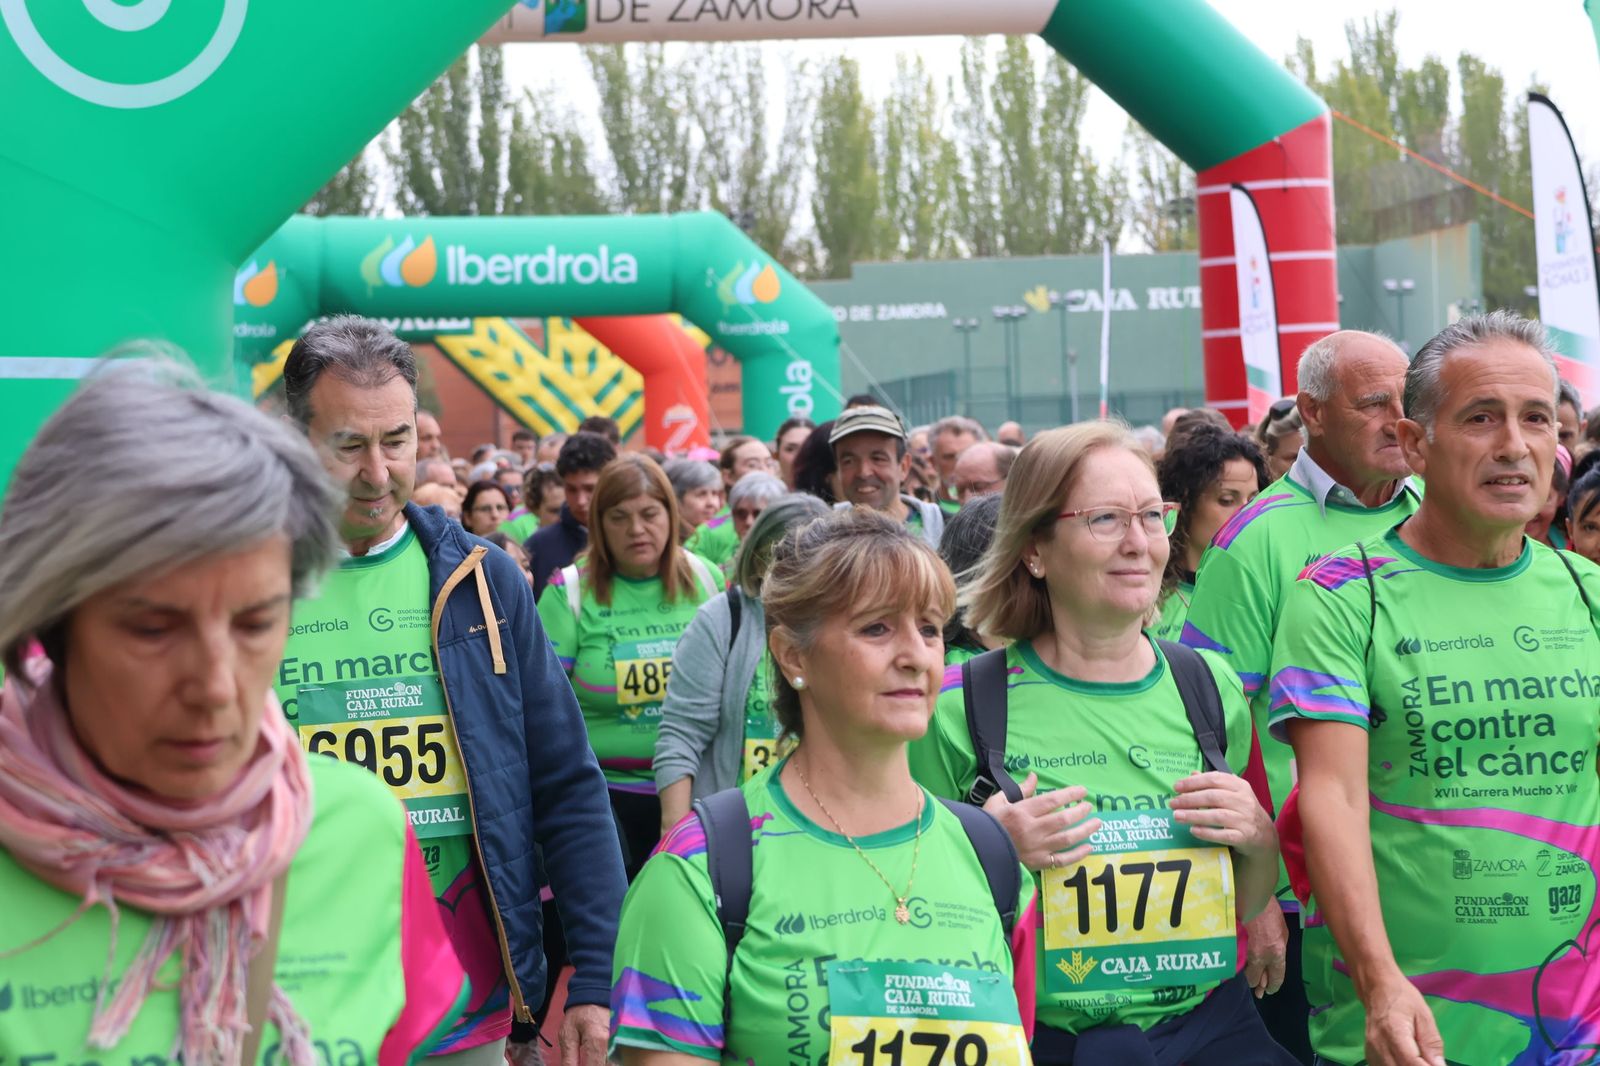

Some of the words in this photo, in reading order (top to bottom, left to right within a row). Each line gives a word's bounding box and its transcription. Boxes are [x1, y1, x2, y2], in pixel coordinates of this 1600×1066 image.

[595, 0, 650, 23] DE
[666, 0, 861, 22] ZAMORA
[446, 243, 638, 285] Iberdrola
[1066, 287, 1138, 312] CAA
[876, 302, 948, 322] ZAMORA
[409, 621, 432, 629] Zamor
[1423, 634, 1495, 653] Iberdrola
[279, 657, 324, 686] En
[1426, 674, 1475, 706] En
[346, 700, 378, 712] CAJA
[381, 695, 424, 709] RURAL
[347, 711, 358, 719] DE
[360, 709, 391, 719] ZAMORA
[1401, 676, 1429, 778] ZAMORA
[1431, 709, 1557, 743] contra
[1033, 750, 1108, 769] Iberdrola
[1434, 746, 1468, 779] el
[1434, 787, 1459, 799] XVII
[1462, 786, 1509, 797] Carrera
[1512, 785, 1553, 797] Mucho
[1555, 784, 1564, 795] X
[406, 806, 465, 826] RURAL
[1089, 830, 1125, 844] CAJA
[1126, 827, 1174, 842] RURAL
[1104, 842, 1139, 852] ZAMORA
[1473, 859, 1527, 872] ZAMORA
[1063, 858, 1193, 935] 1177
[1548, 883, 1582, 915] gaza
[808, 905, 887, 931] Iberdrola
[1455, 906, 1486, 917] CAJA
[1489, 906, 1530, 917] RURAL
[1100, 955, 1152, 975] CAJA
[1155, 951, 1227, 971] RURAL
[884, 988, 923, 1005] CAJA
[927, 990, 976, 1008] RURAL
[886, 1004, 897, 1014] DE
[900, 1005, 939, 1016] ZAMORA
